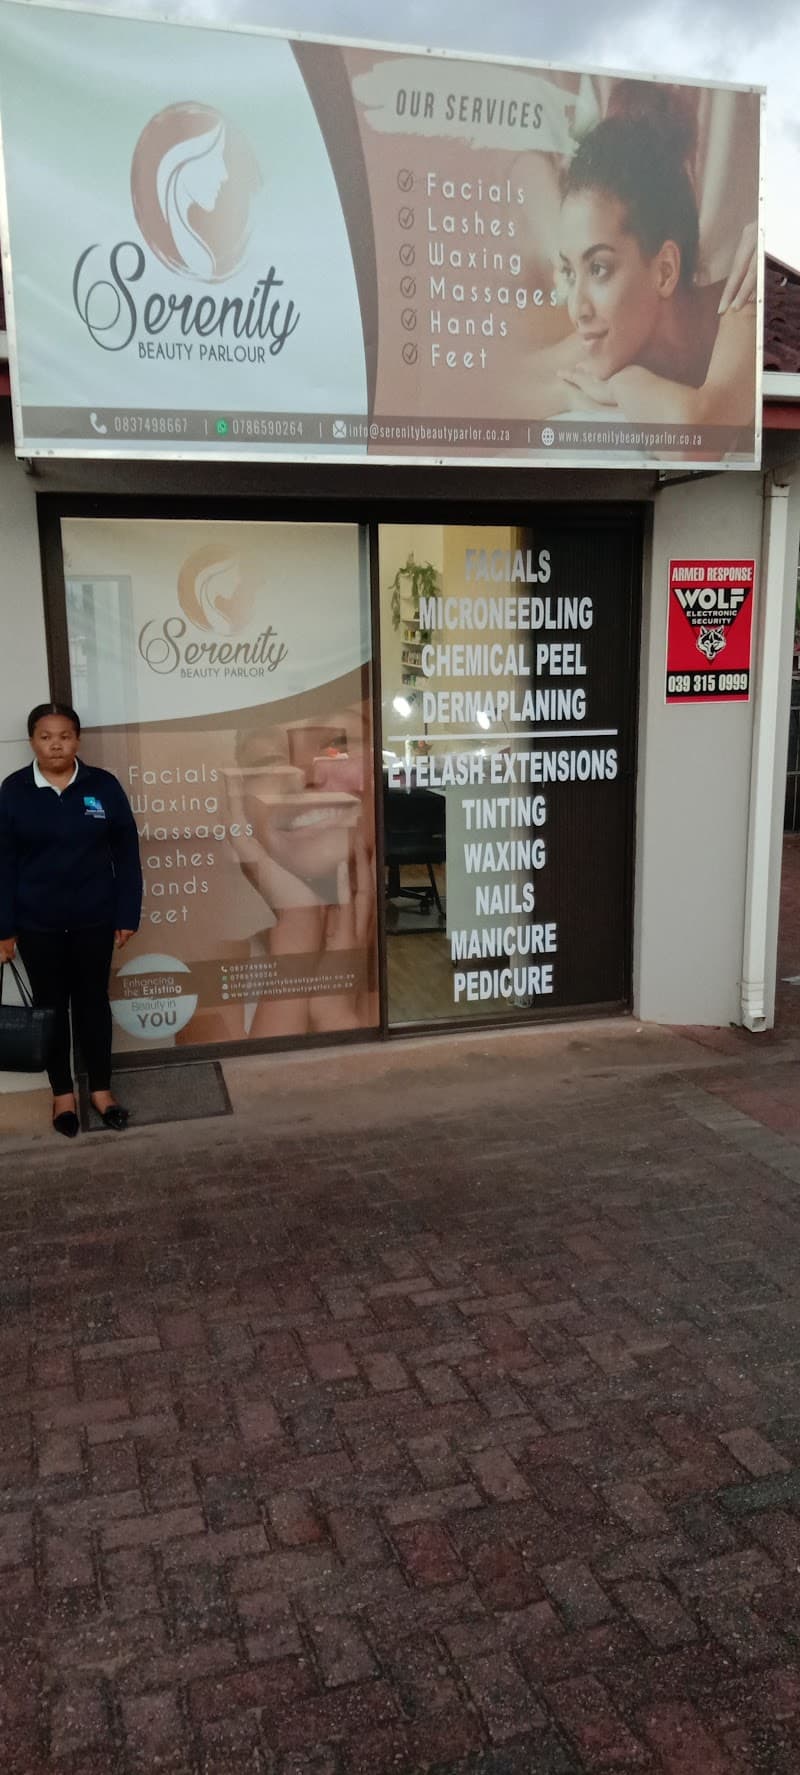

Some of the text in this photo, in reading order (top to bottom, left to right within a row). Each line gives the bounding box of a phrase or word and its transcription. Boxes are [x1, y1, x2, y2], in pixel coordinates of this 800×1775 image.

[396, 89, 543, 130] OUR SERVICES
[427, 172, 525, 204] Facials
[427, 207, 515, 237] Lashes
[428, 242, 522, 275] Waxing
[72, 241, 301, 356] Serenity
[430, 276, 558, 309] Massages
[430, 310, 508, 336] Hands
[138, 341, 266, 363] BEAUTY PARLOUR
[431, 343, 487, 369] Feet
[114, 416, 703, 446] 0837498667 0786590264 info@serenitybeautyparlor.co.za www.serenitybeautyparlor.co.za
[465, 549, 551, 583] FACIALS
[672, 567, 753, 582] ARMED RESPONSE
[419, 597, 593, 630] MICRONEEDLING
[674, 588, 744, 609] WOLF
[138, 617, 288, 674] Serenity
[421, 643, 587, 676] CHEMICAL PEEL
[180, 667, 265, 678] BEAUTY PARLOR
[668, 673, 748, 693] 039 315 0999
[423, 689, 586, 723] DERMAPLANING
[128, 764, 218, 785] Facials
[388, 749, 618, 788] EYELASH EXTENSIONS
[130, 795, 218, 814] Waxing
[462, 795, 546, 830] TINTING
[142, 849, 215, 869] ashes
[463, 838, 546, 873] WAXING
[475, 882, 535, 916] NAILS
[451, 923, 557, 960] MANICURE
[123, 976, 175, 988] Enhancing
[143, 985, 182, 996] Existing
[454, 964, 553, 1002] PEDICURE
[137, 1011, 177, 1028] YOU
